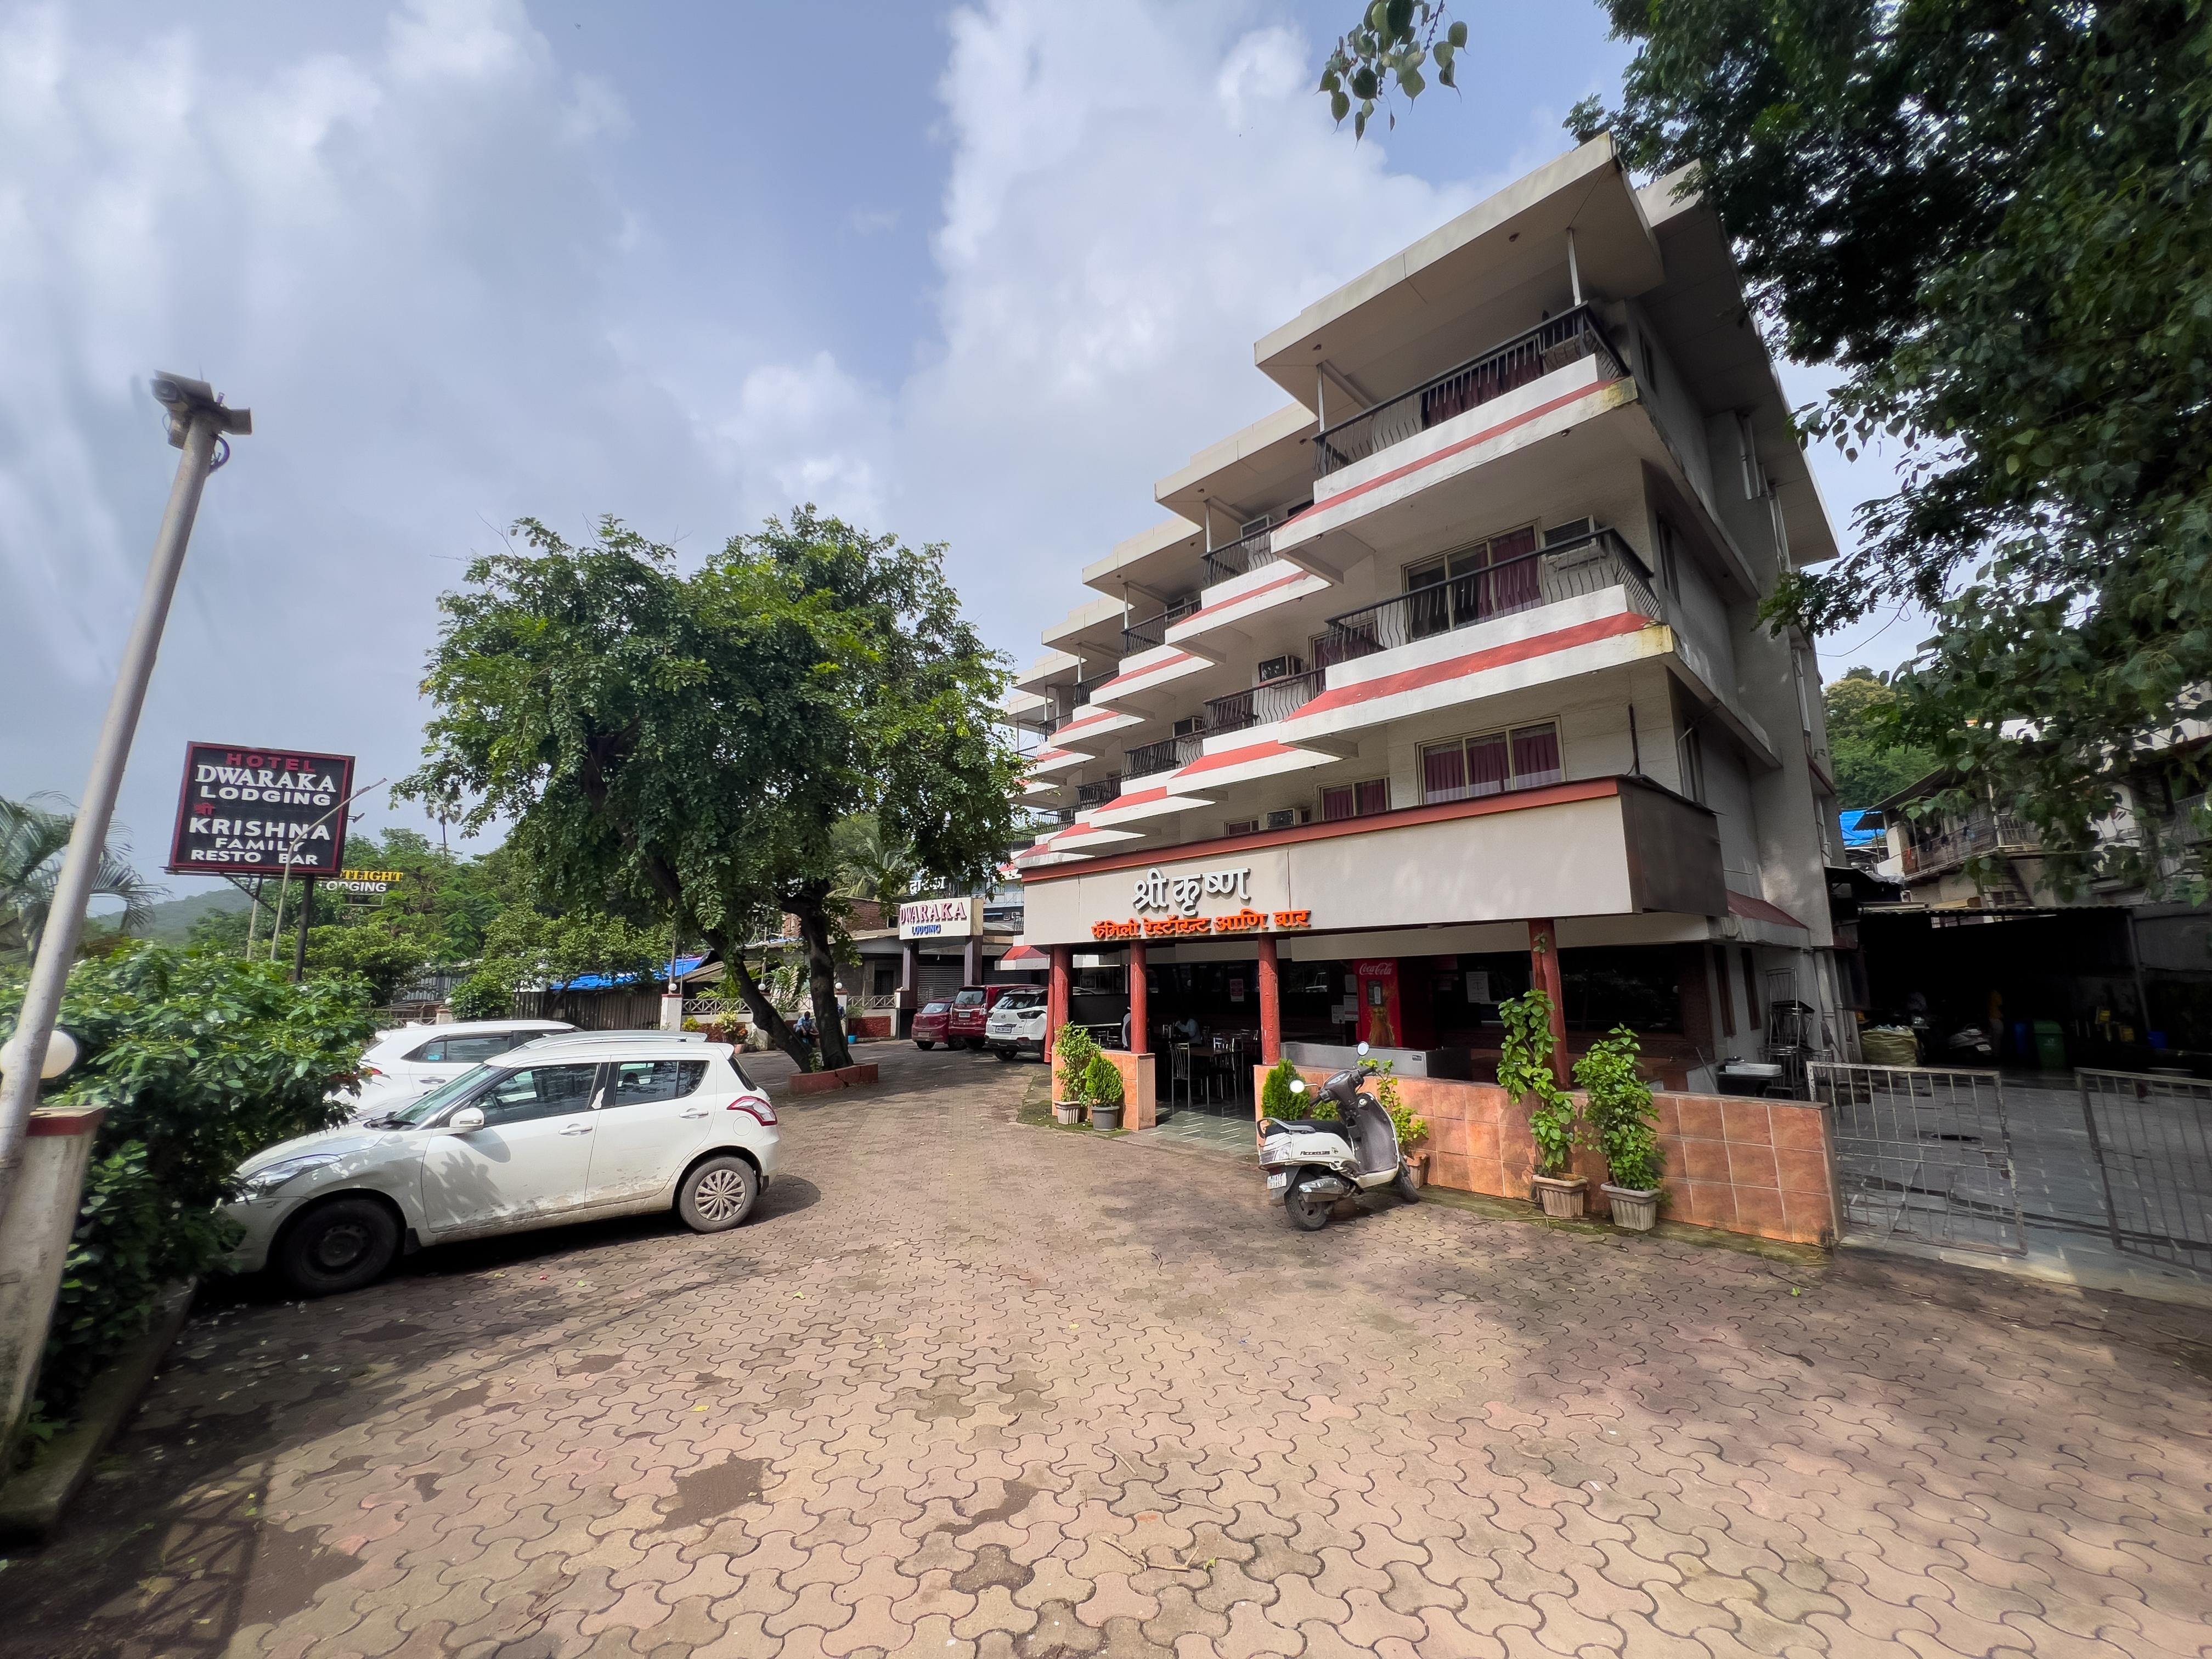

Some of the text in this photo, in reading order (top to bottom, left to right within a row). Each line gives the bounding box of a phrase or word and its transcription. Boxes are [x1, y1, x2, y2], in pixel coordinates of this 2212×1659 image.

[225, 753, 315, 772] HOTEL
[195, 764, 336, 793] DWARAKA
[200, 785, 331, 806] LODGING
[188, 817, 330, 840] KRISHNA
[215, 837, 305, 852] FAMILY
[190, 849, 318, 865] RESTO BAR
[340, 869, 404, 882] TLIGHT
[319, 880, 387, 893] ODGING
[1131, 867, 1250, 916] श्री कृष्ण
[900, 901, 967, 926] DWARAKA
[1212, 907, 1269, 932] आणि
[1272, 909, 1311, 927] बार
[912, 924, 941, 936] LODGING
